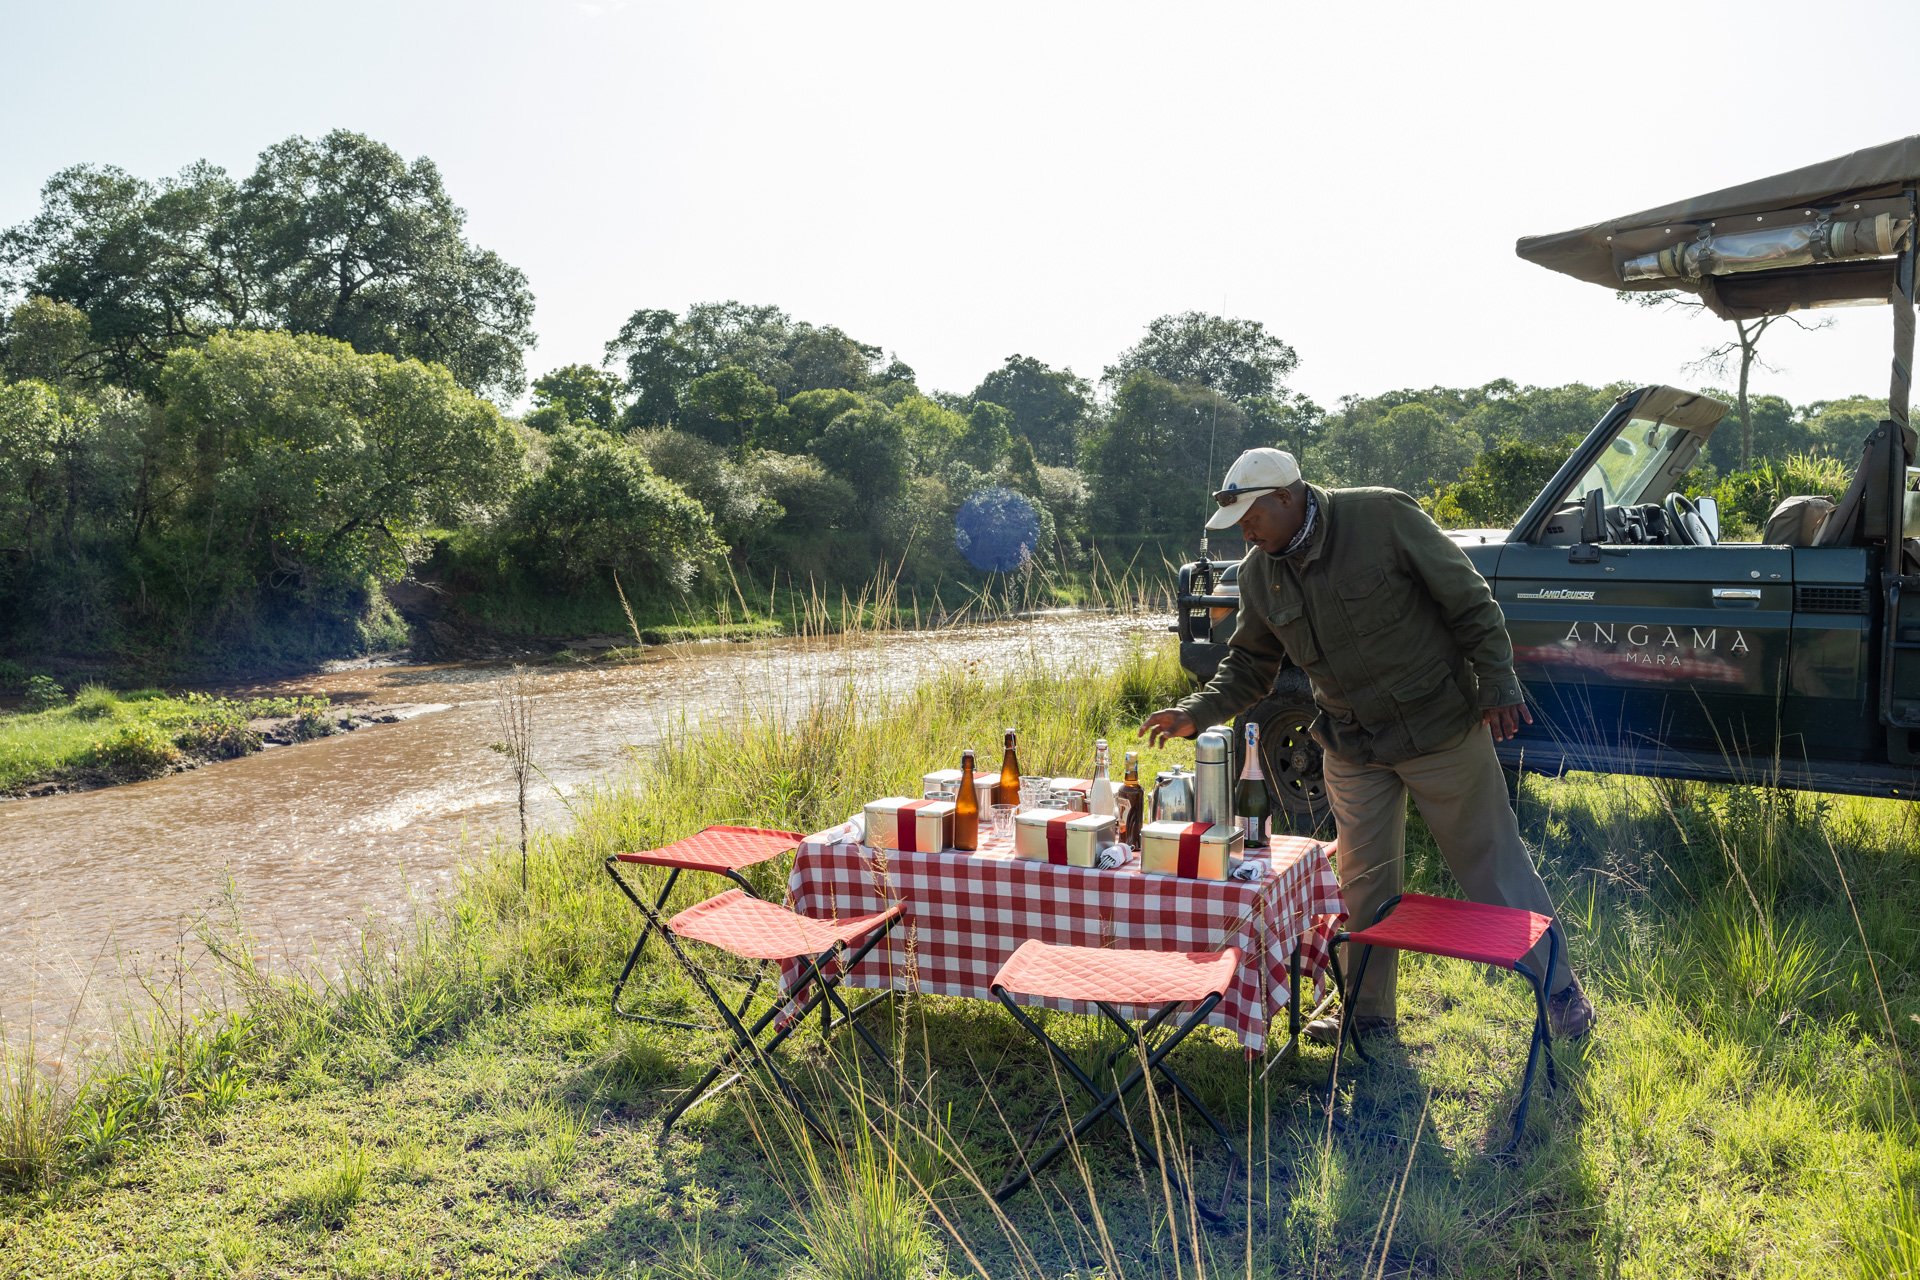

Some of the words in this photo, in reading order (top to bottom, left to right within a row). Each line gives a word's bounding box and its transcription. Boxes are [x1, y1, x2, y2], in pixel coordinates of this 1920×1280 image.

[1560, 589, 1595, 600] CRUISER
[1565, 621, 1749, 652] ANGAMA
[1626, 652, 1681, 666] MARA
